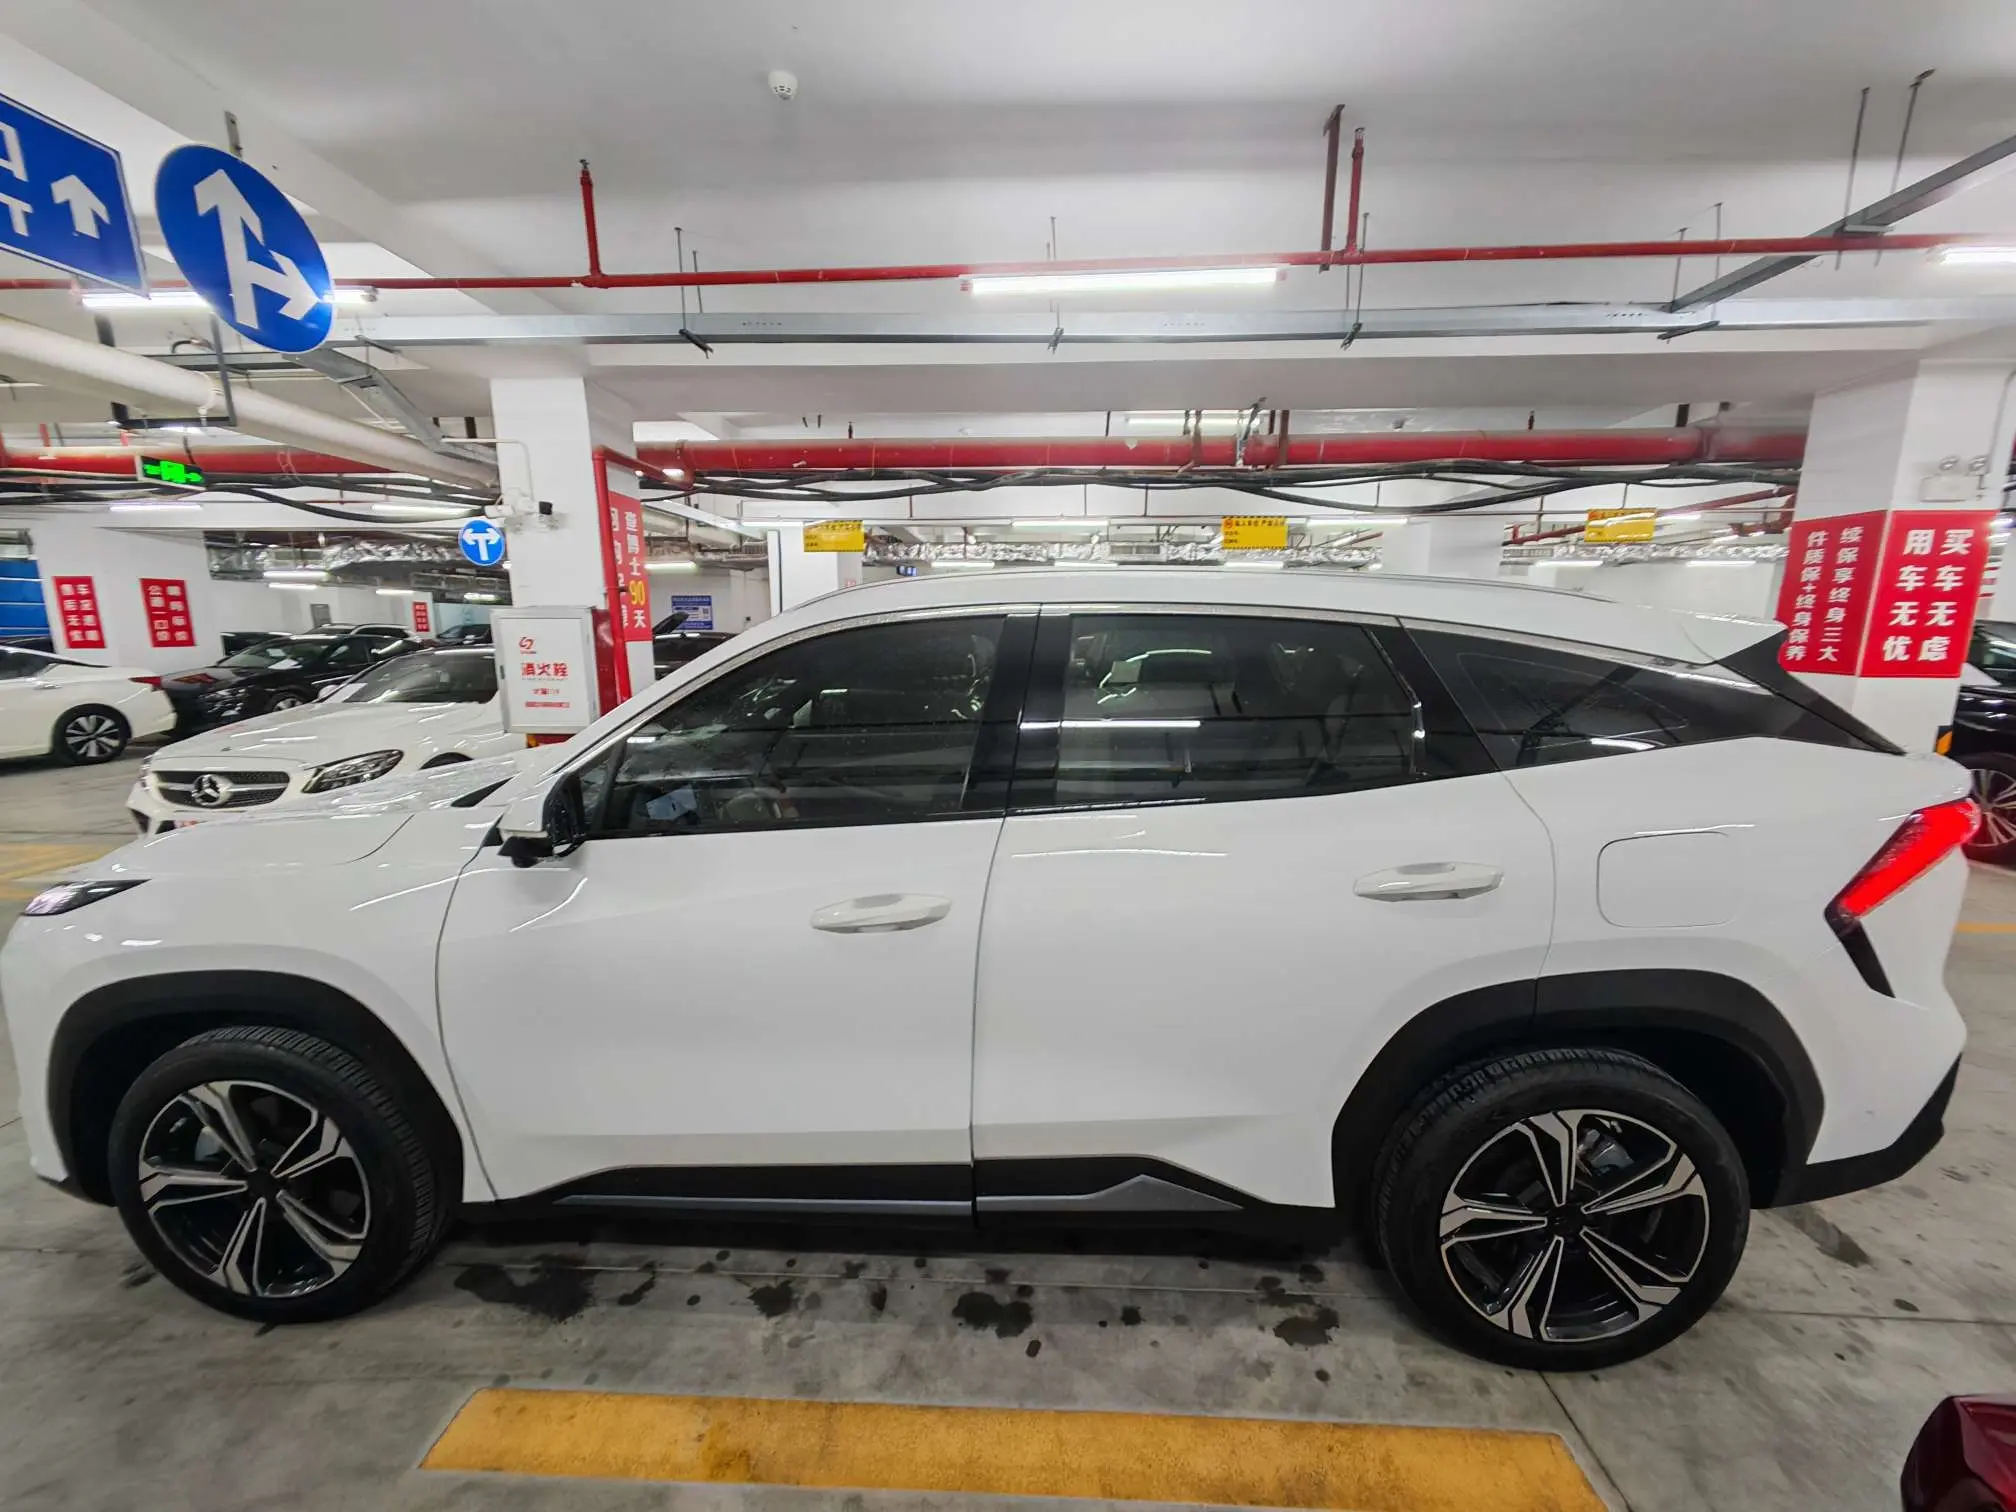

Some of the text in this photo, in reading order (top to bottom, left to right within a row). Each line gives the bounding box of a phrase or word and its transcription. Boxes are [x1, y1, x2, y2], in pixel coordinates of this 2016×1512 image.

[1817, 526, 1864, 662] 续保享终身三大
[1882, 528, 1936, 662] 用车无忧
[1918, 528, 1975, 662] 买车无虑
